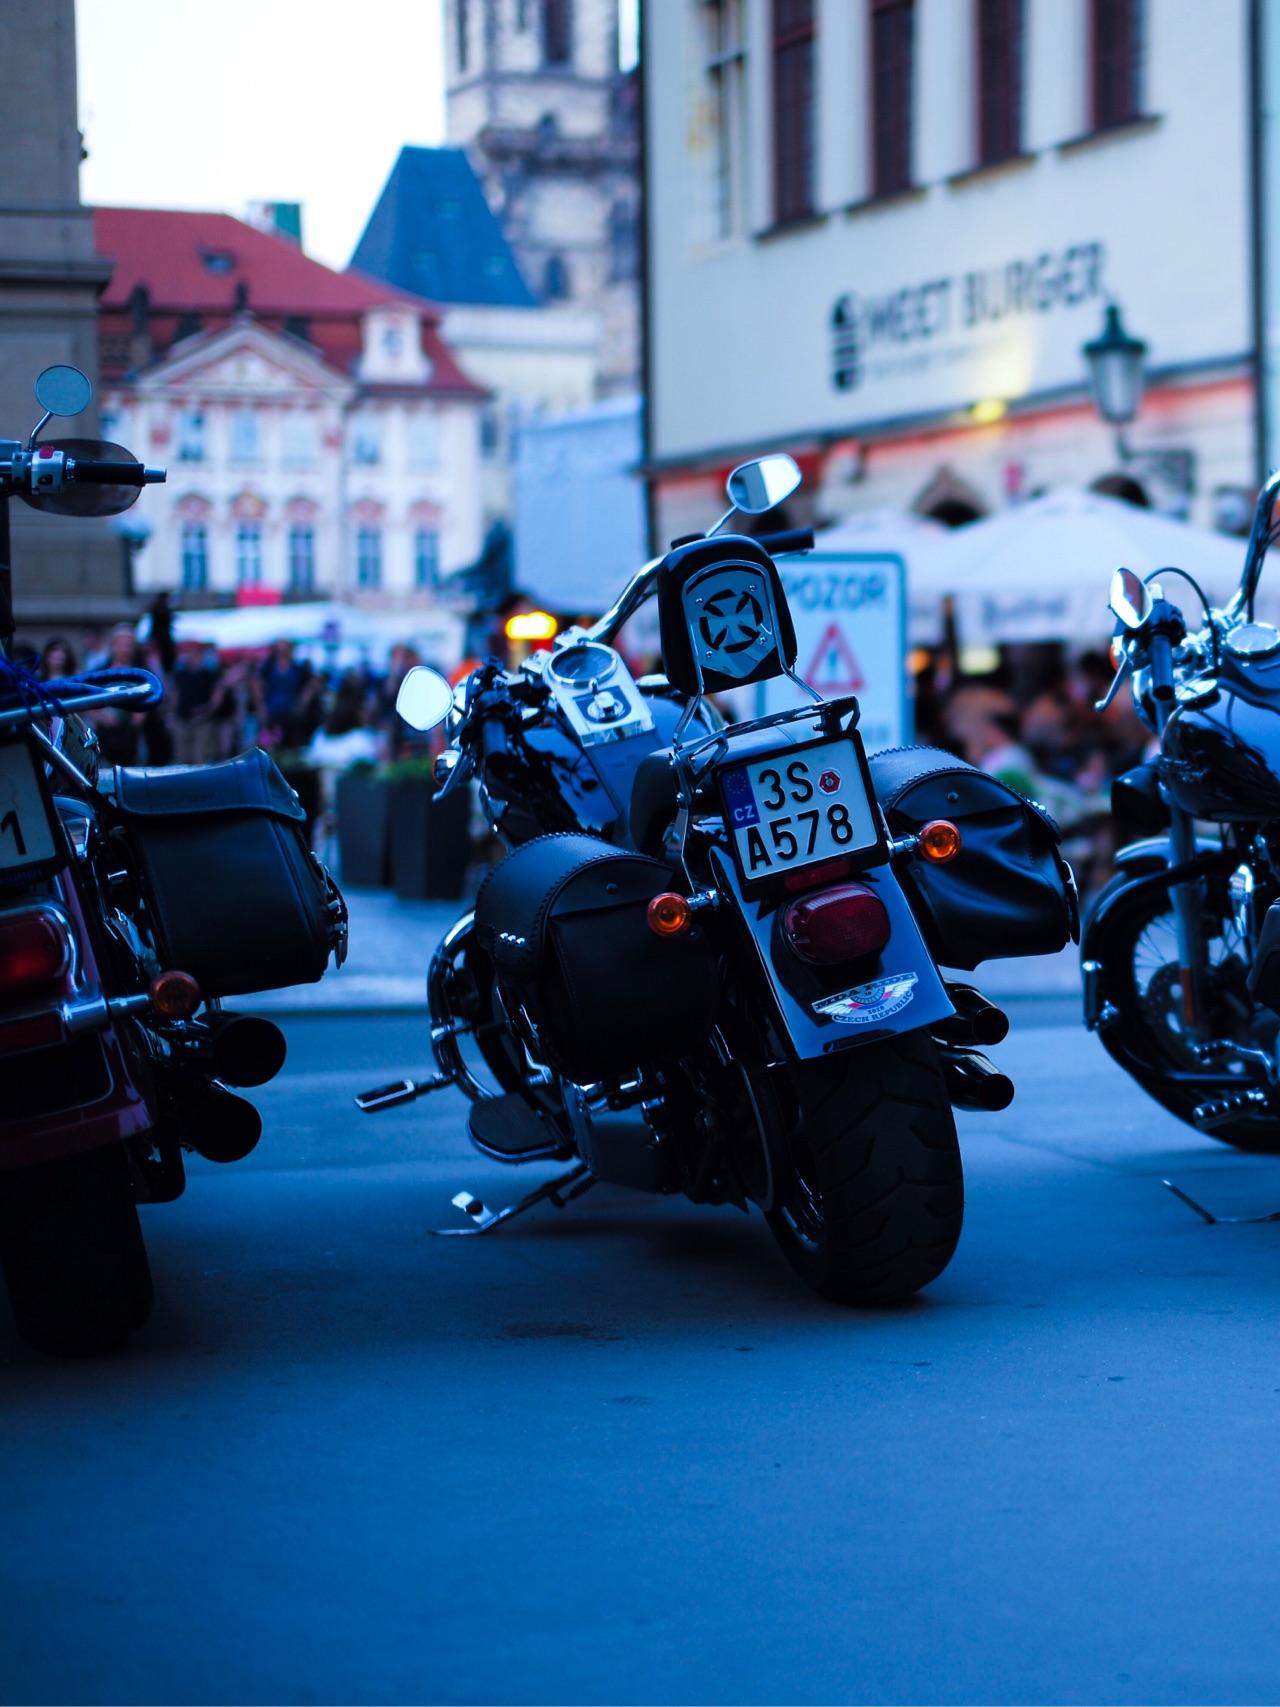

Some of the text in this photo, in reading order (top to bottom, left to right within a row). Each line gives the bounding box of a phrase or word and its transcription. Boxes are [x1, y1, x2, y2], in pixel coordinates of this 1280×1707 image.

[866, 240, 1104, 342] MEET BURGER
[758, 761, 814, 811] 3S
[734, 805, 756, 822] CZ
[746, 803, 853, 871] A578
[833, 990, 913, 1022] CZECH REPUBLIC
